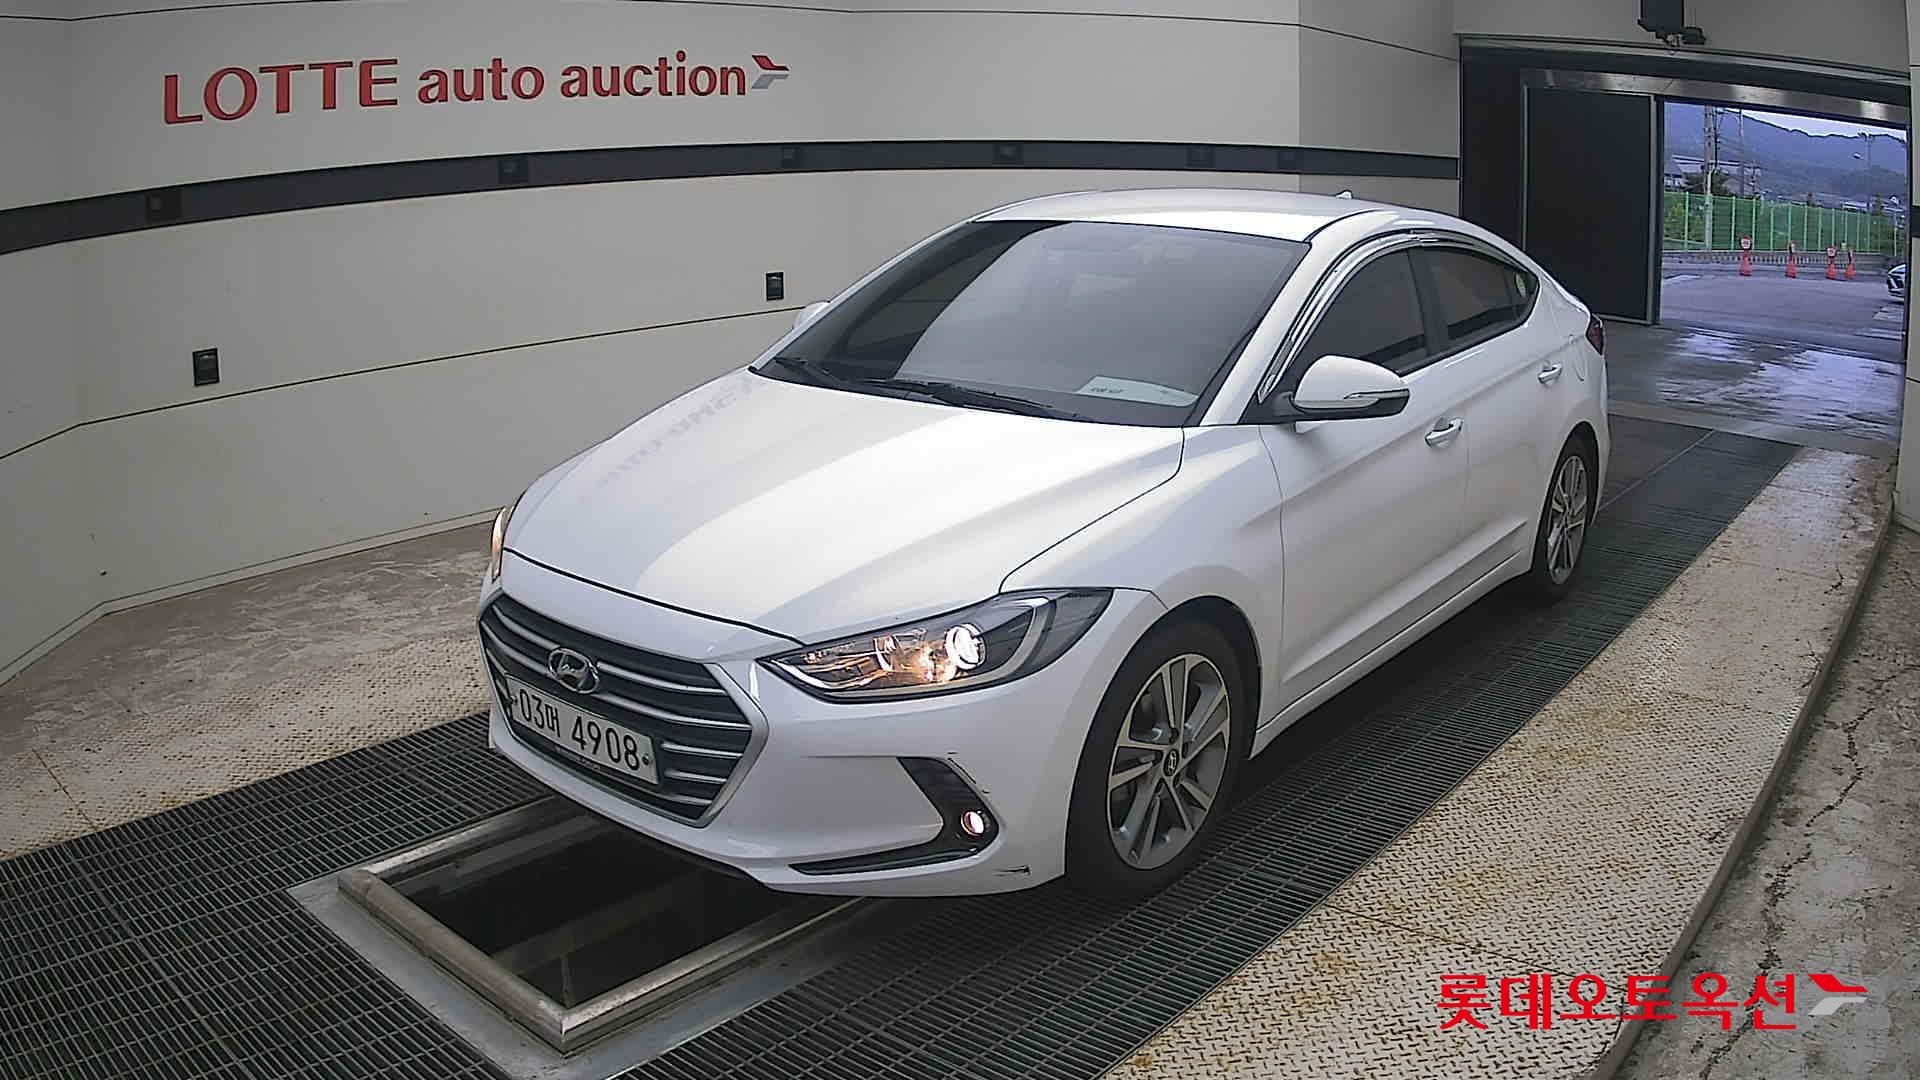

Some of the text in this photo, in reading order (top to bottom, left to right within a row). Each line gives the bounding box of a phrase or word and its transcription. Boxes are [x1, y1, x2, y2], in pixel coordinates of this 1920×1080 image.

[163, 50, 746, 125] LOTTE auto auction
[519, 688, 641, 771] 03머 4908
